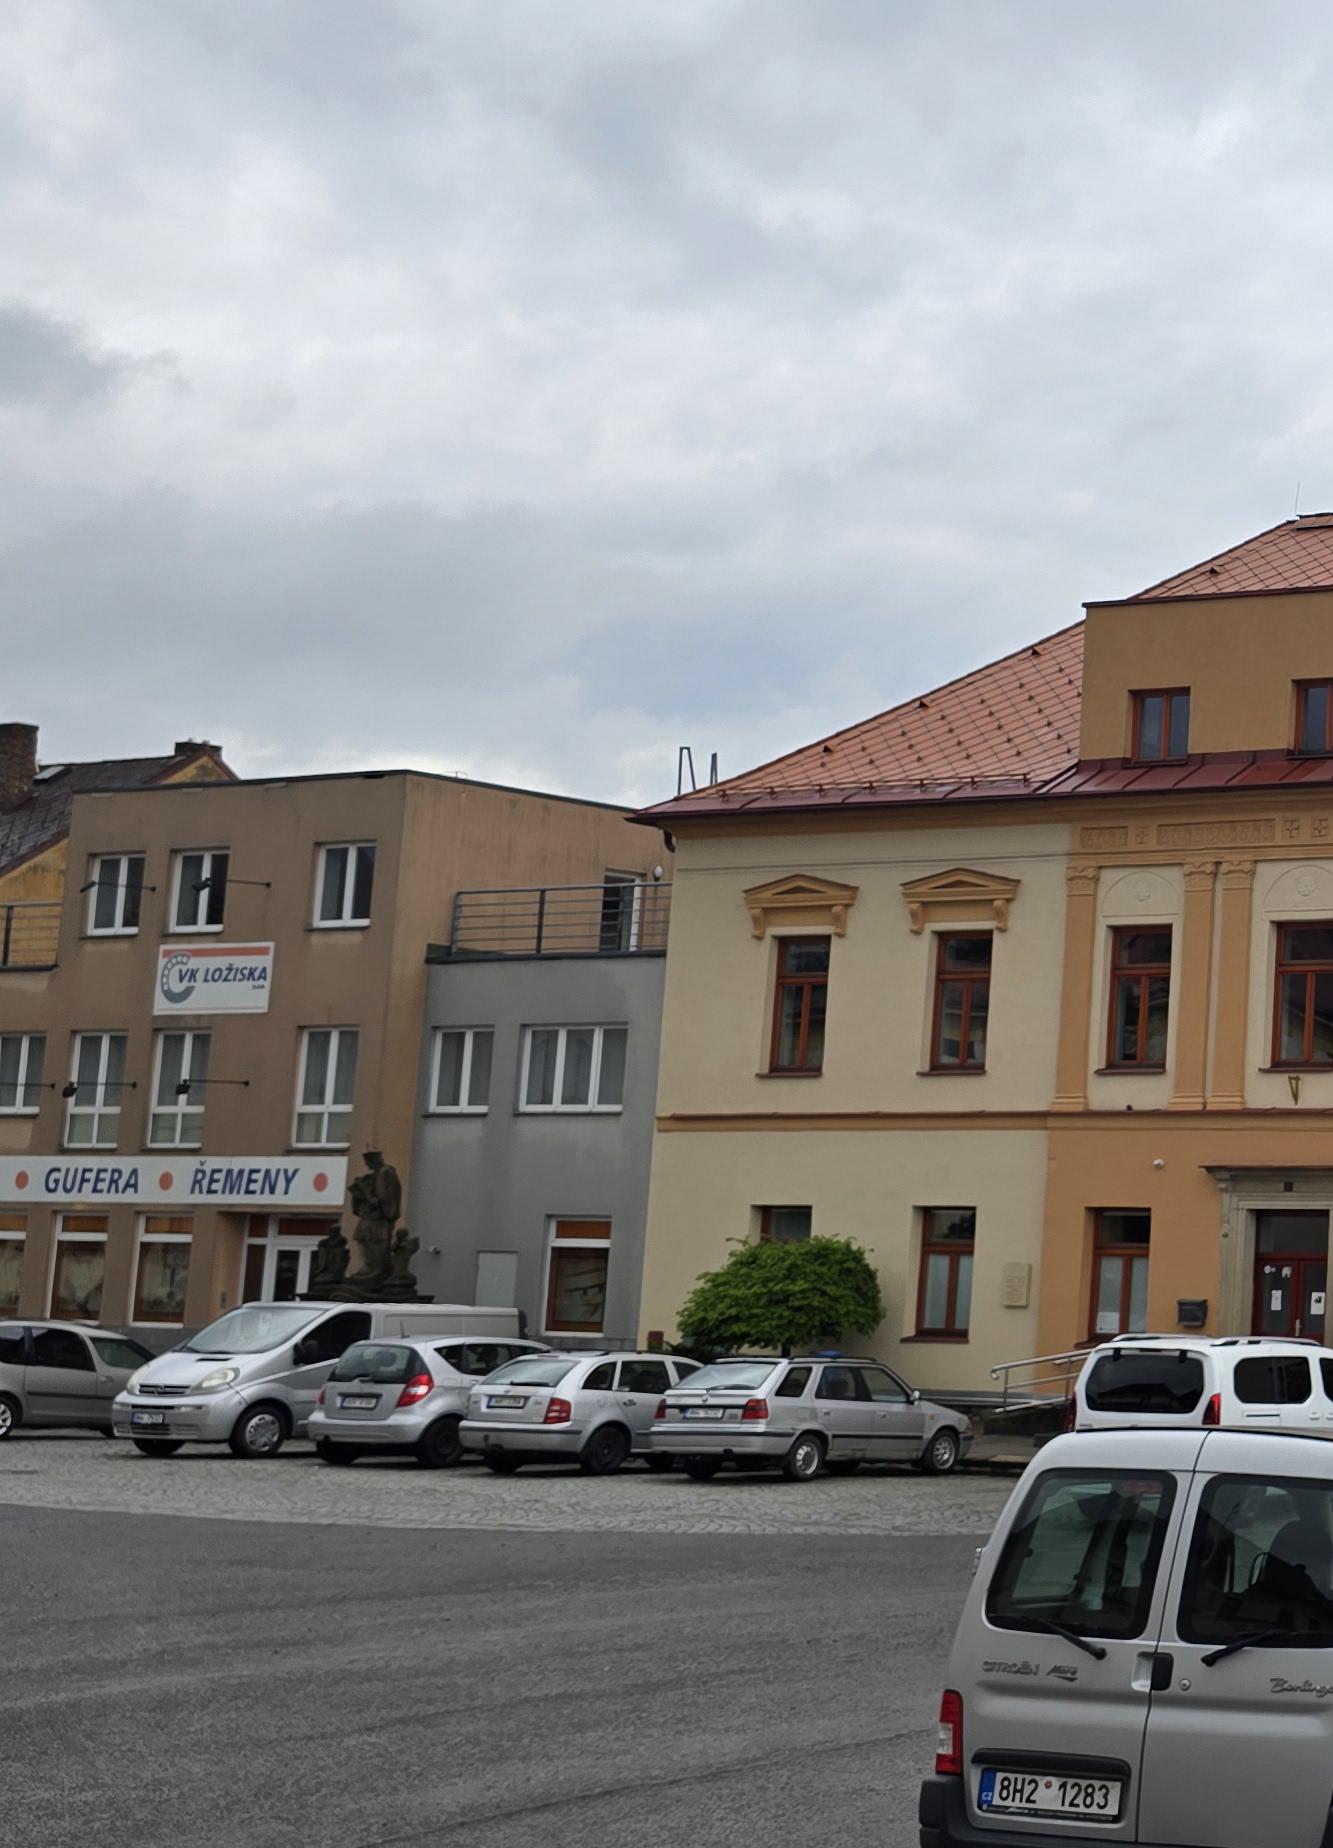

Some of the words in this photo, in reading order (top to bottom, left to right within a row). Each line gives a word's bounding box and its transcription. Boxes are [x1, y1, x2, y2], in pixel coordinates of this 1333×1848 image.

[178, 967, 200, 983] VK
[203, 963, 267, 983] LOŽISKA
[44, 1167, 139, 1194] GUFERA
[190, 1160, 299, 1195] ŘEMENY
[999, 1776, 1039, 1804] 8H2
[1058, 1781, 1110, 1810] 1283
